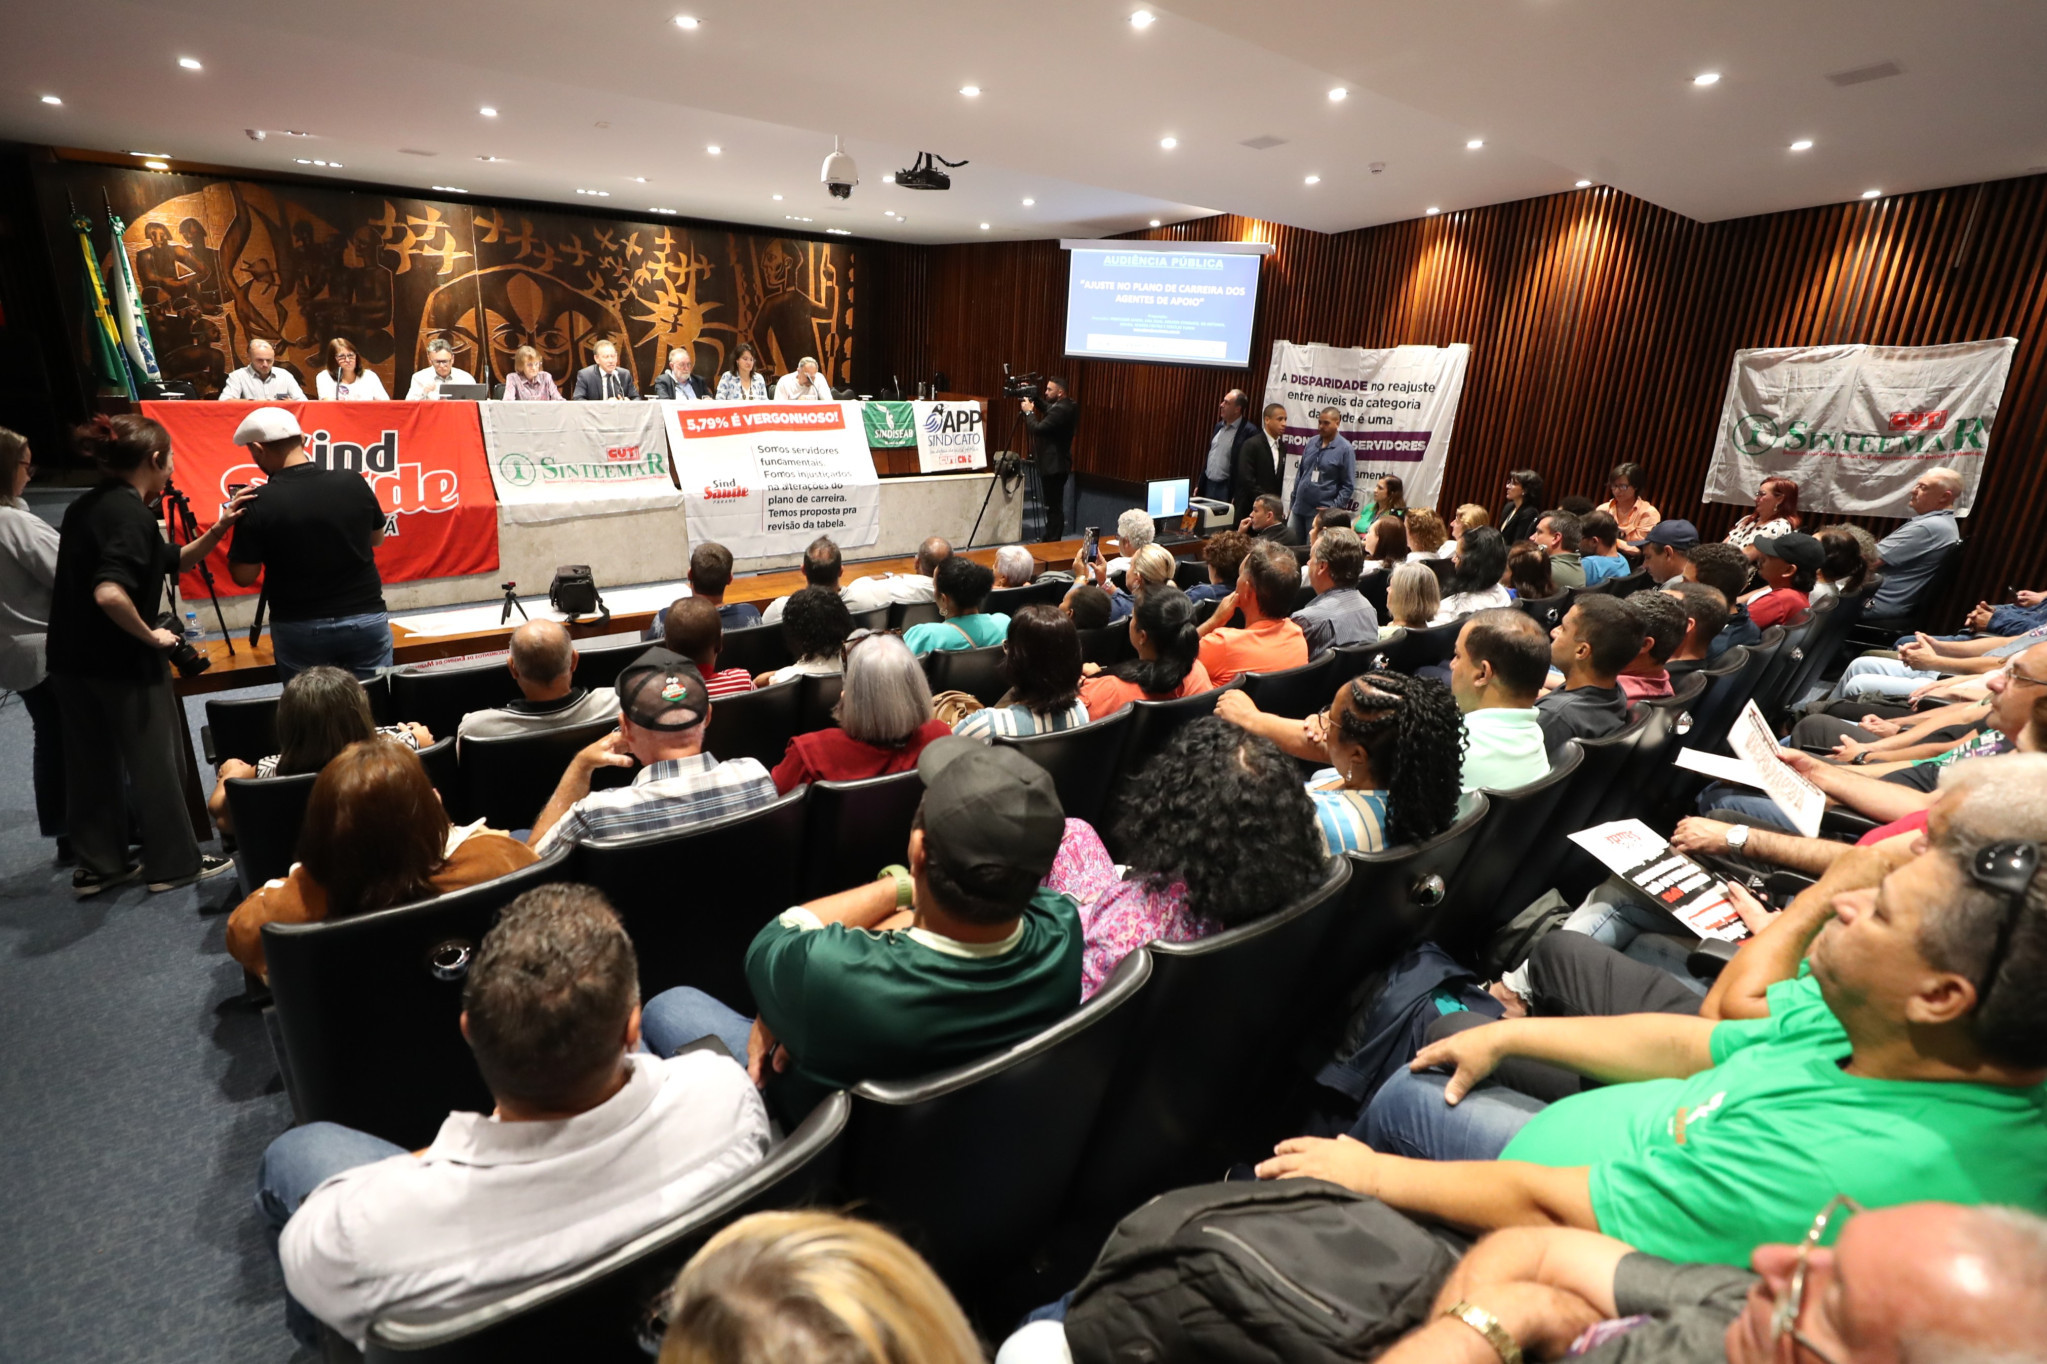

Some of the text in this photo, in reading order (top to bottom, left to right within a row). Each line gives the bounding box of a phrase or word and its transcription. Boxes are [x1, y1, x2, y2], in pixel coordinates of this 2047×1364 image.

[1104, 254, 1223, 269] AUDIÊNCIA PÚBLICA
[1117, 281, 1131, 291] NO
[1133, 282, 1163, 292] PLANO
[1165, 284, 1176, 293] DE
[1178, 284, 1223, 295] CARREIRA
[1226, 286, 1245, 296] DOS
[1115, 294, 1154, 304] AGENTES
[1157, 296, 1168, 305] DE
[1281, 373, 1436, 394] A DISPARIDADE no reajuste
[1287, 391, 1314, 402] entre
[1350, 396, 1363, 408] da
[1366, 398, 1421, 411] categoria
[687, 411, 839, 432] 5,79% É VERGONHOSO!
[942, 409, 982, 433] APP
[1358, 413, 1365, 424] é
[1368, 416, 1393, 425] uma
[1891, 411, 1942, 426] CUT
[874, 429, 914, 438] SINDISEAB
[928, 432, 981, 447] SINDICATO
[1784, 417, 1984, 451] SINTEEMAR
[303, 429, 399, 473] ind
[757, 445, 839, 455] Somos servidores
[1351, 439, 1426, 451] SERVIDORES
[608, 447, 635, 458] CUT
[540, 452, 666, 479] SINTEEMAR
[763, 470, 796, 478] Fomos
[713, 478, 736, 488] Sind
[768, 493, 847, 506] plano de carreira.
[768, 507, 857, 518] Temos proposta pra
[768, 519, 846, 531] revisão da tabela.
